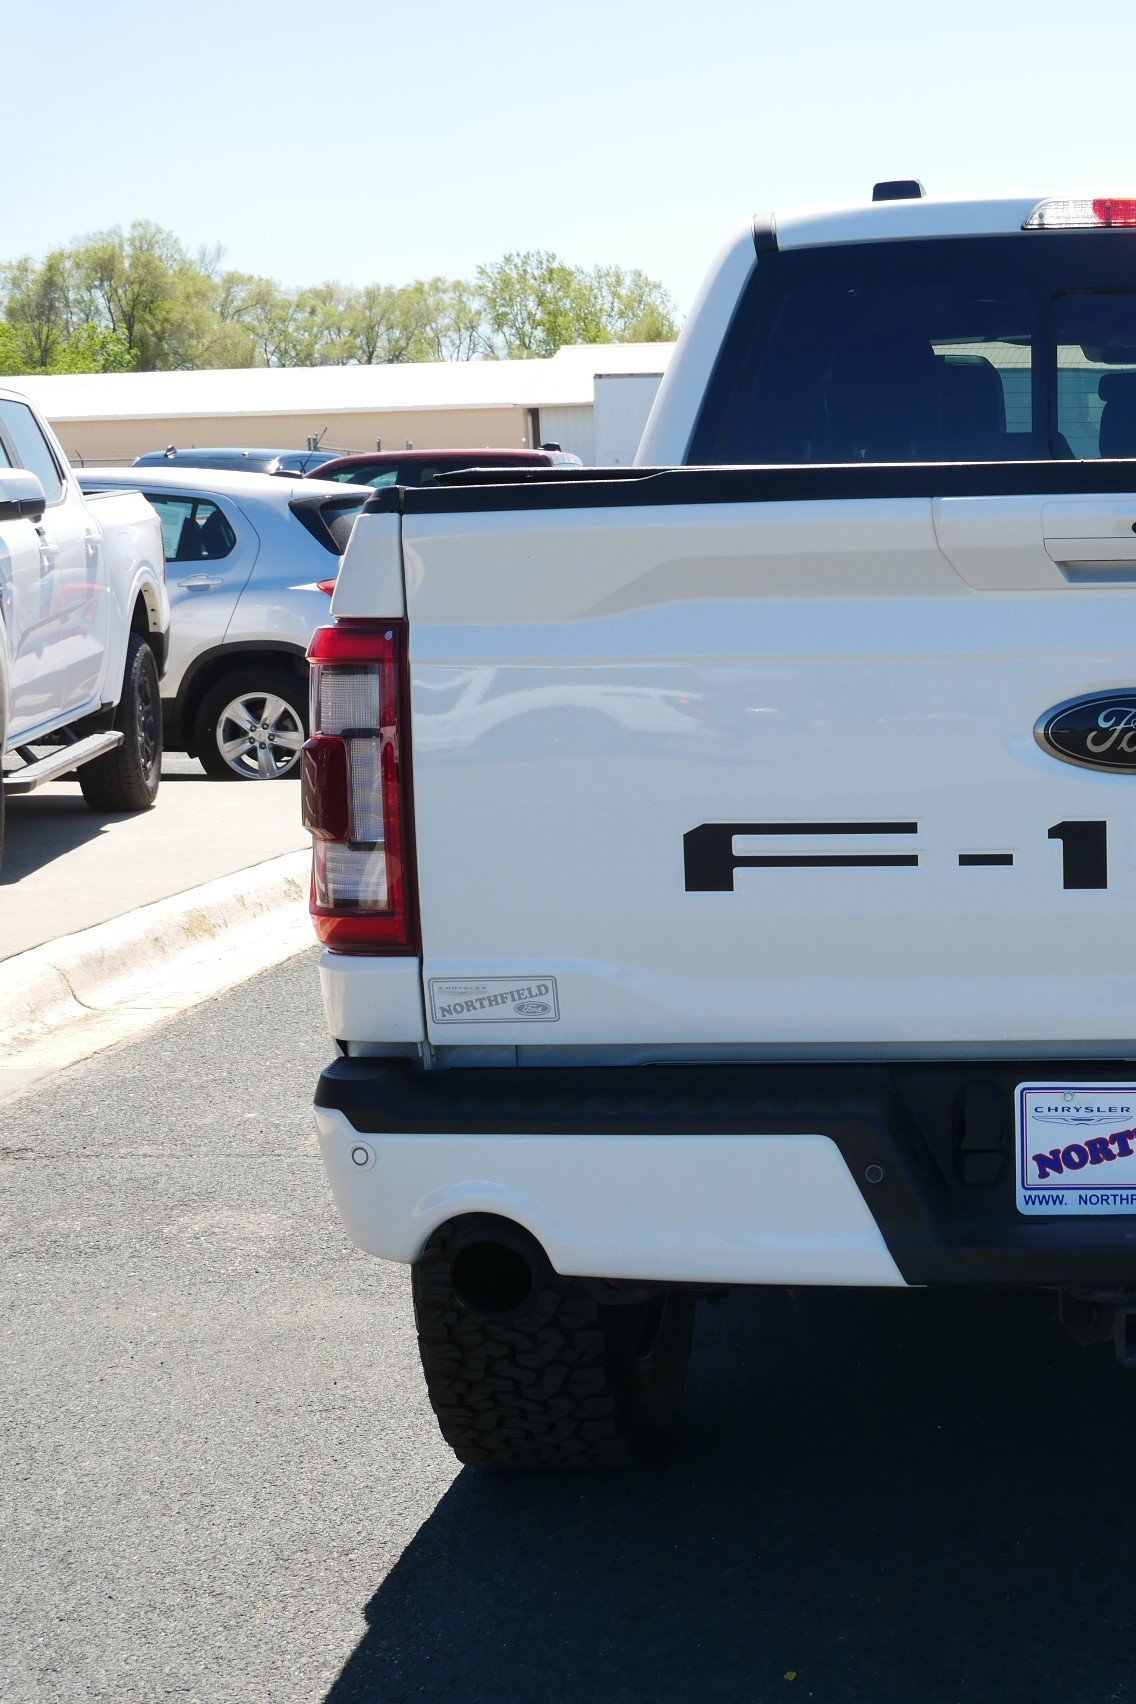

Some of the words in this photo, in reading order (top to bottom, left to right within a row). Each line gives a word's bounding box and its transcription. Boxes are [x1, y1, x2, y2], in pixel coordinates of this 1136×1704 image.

[438, 983, 550, 1018] NORTHFIELD
[1033, 1105, 1132, 1114] CHRYSLER
[1023, 1194, 1068, 1206] WWW.
